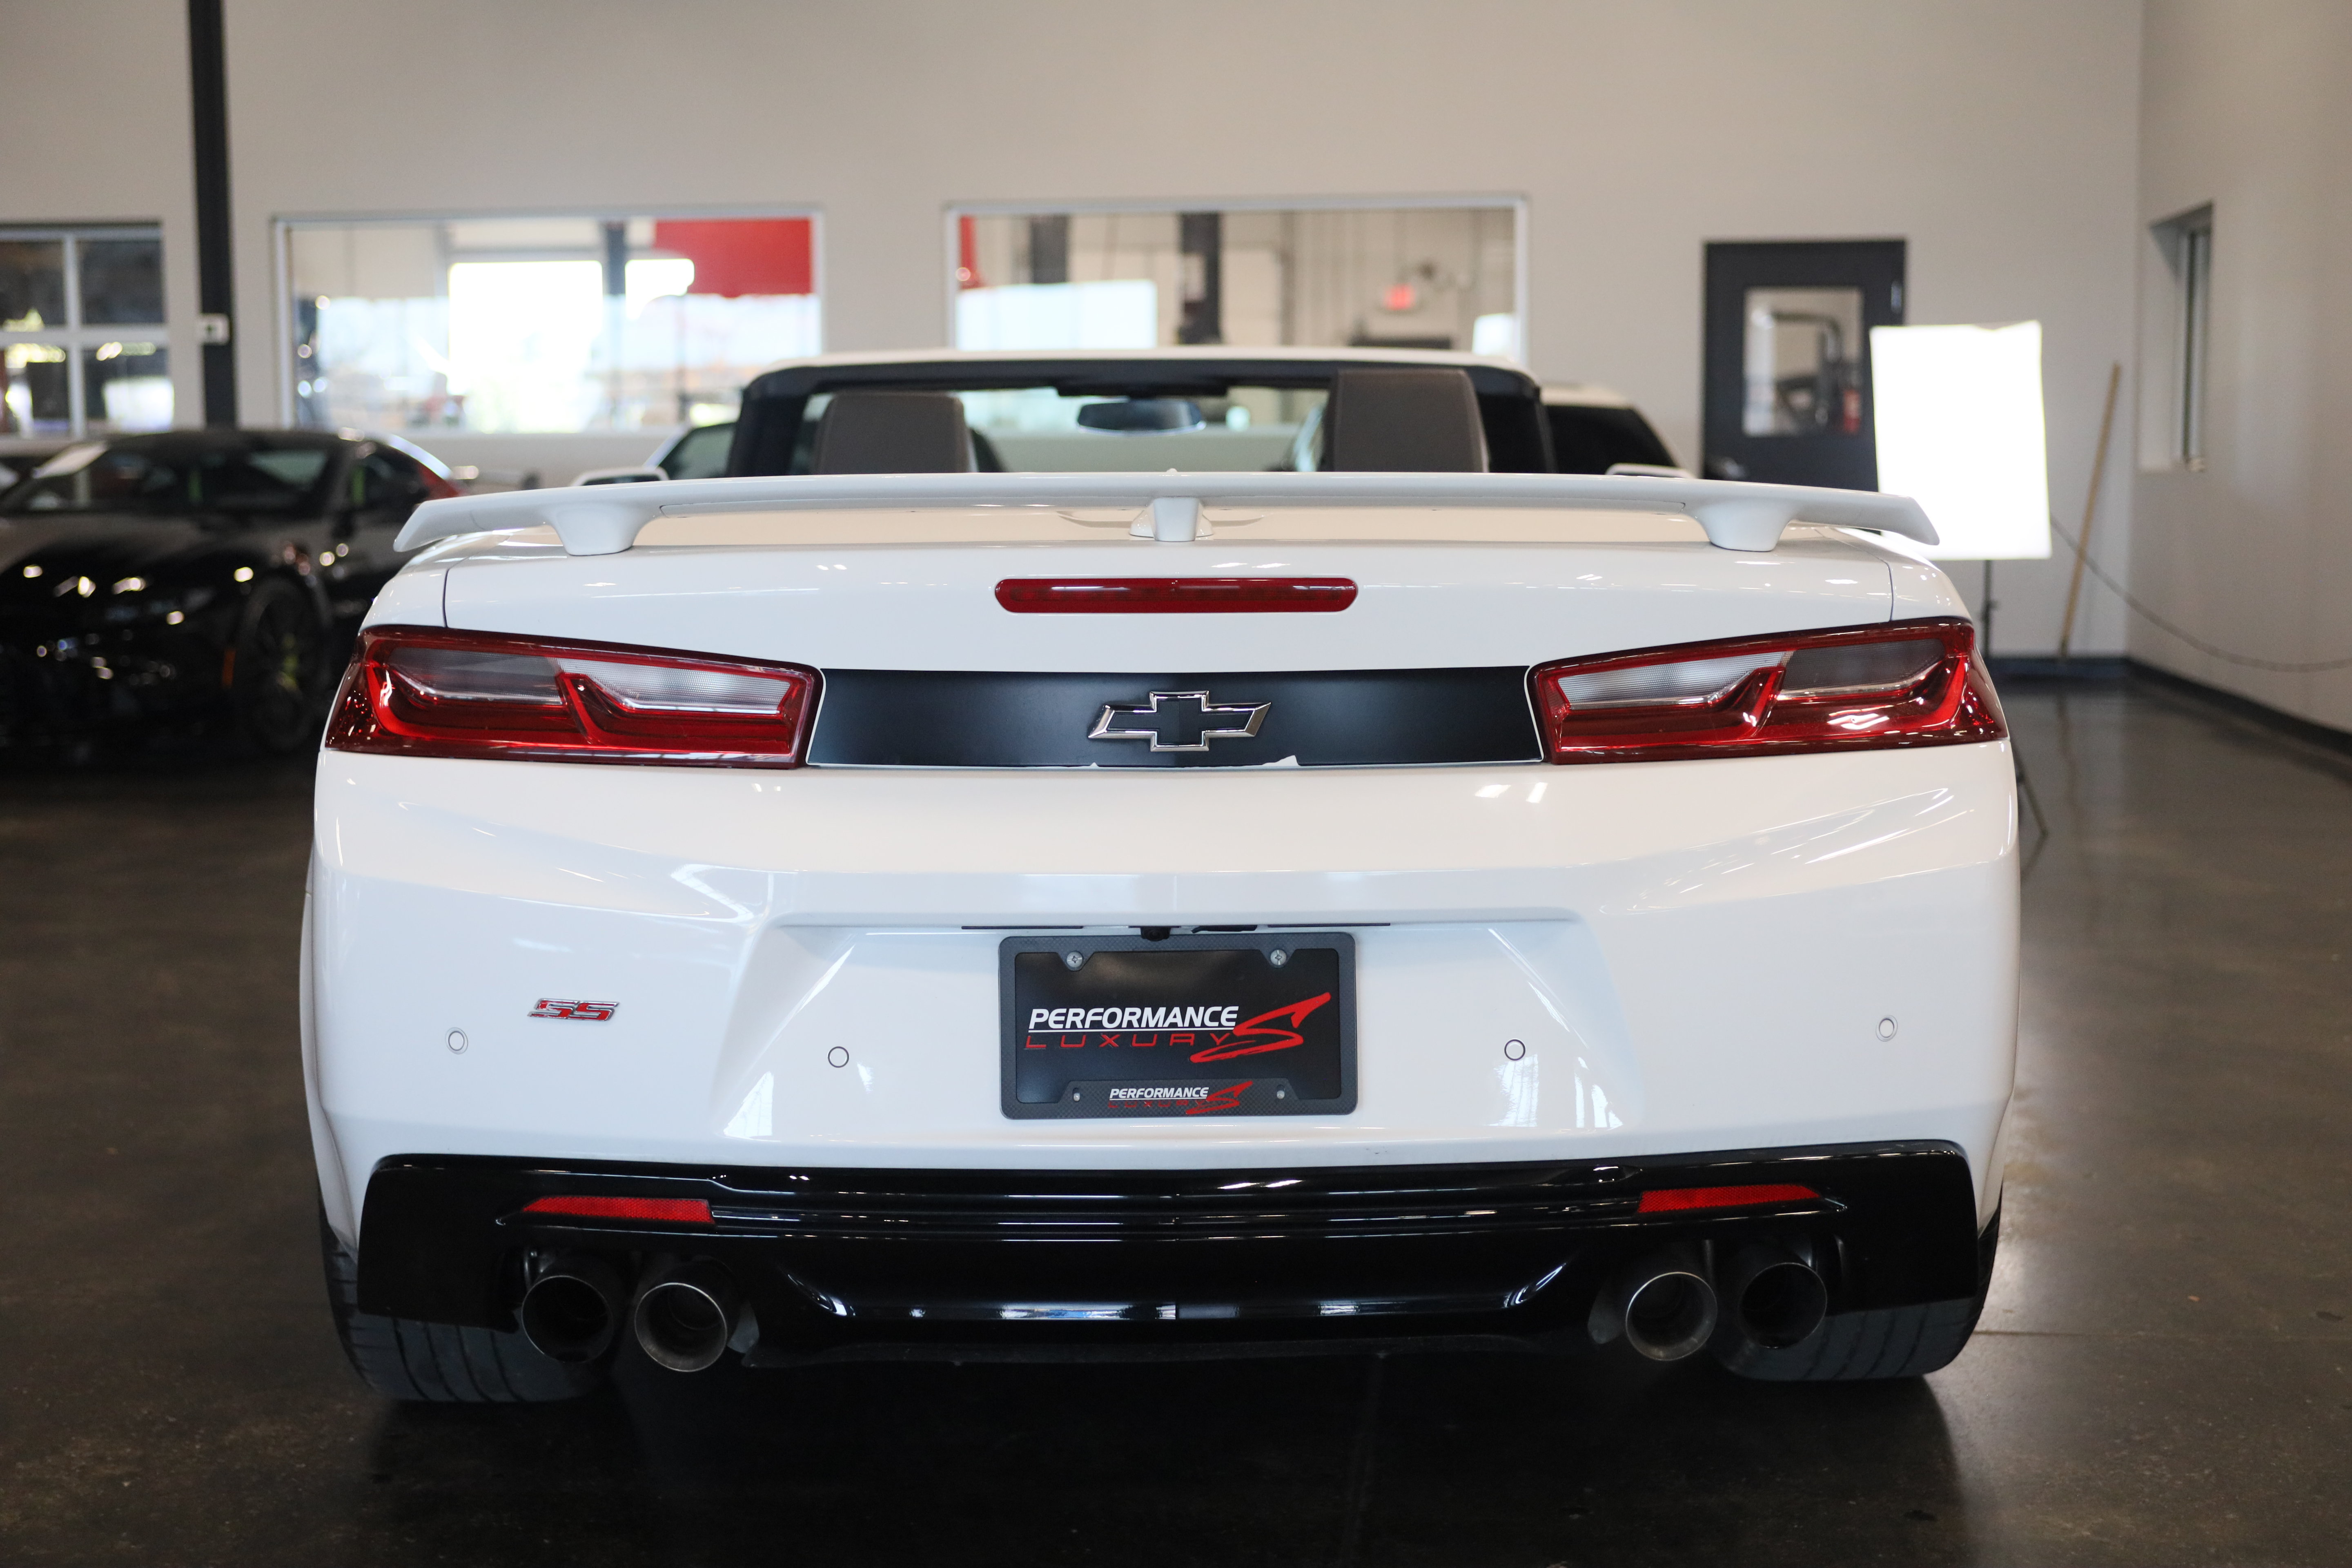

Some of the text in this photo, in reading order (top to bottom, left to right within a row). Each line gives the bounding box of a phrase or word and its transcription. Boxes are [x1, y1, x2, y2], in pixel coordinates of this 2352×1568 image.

[527, 998, 619, 1021] SS
[1029, 1006, 1239, 1030] PERFORMANCE
[1025, 1032, 1231, 1049] LUXURY
[1109, 1087, 1209, 1099] PERFORMANCE
